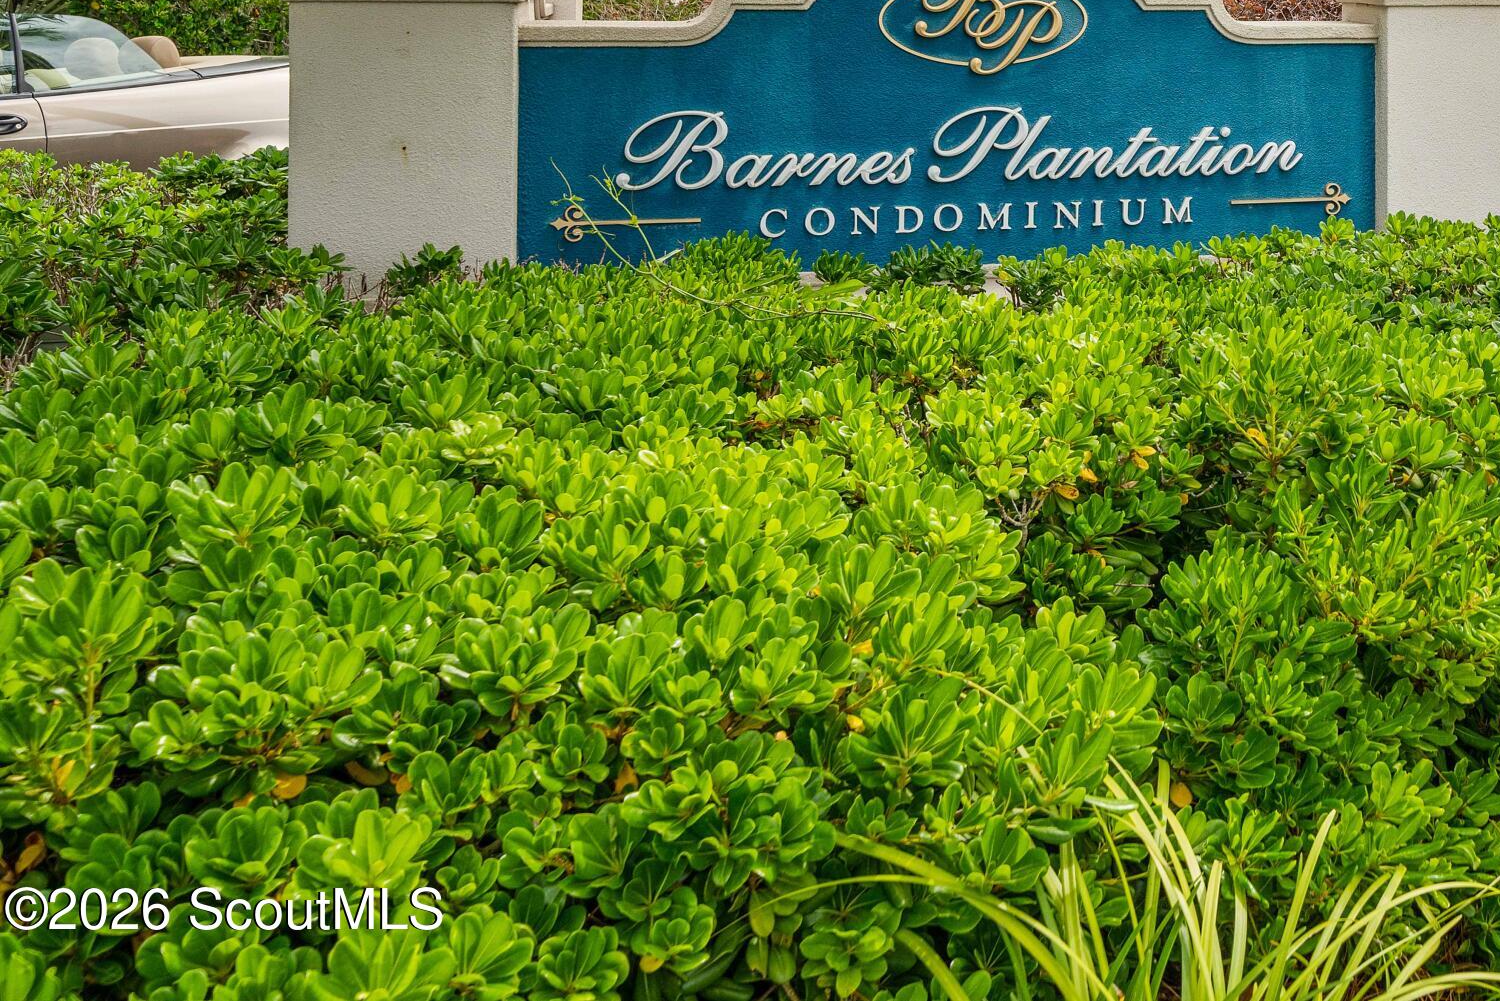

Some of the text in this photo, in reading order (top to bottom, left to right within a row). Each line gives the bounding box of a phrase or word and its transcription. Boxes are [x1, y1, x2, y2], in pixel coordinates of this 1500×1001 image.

[615, 106, 1303, 191] Barnes Plantation
[759, 196, 1194, 239] CONDOMINIUM
